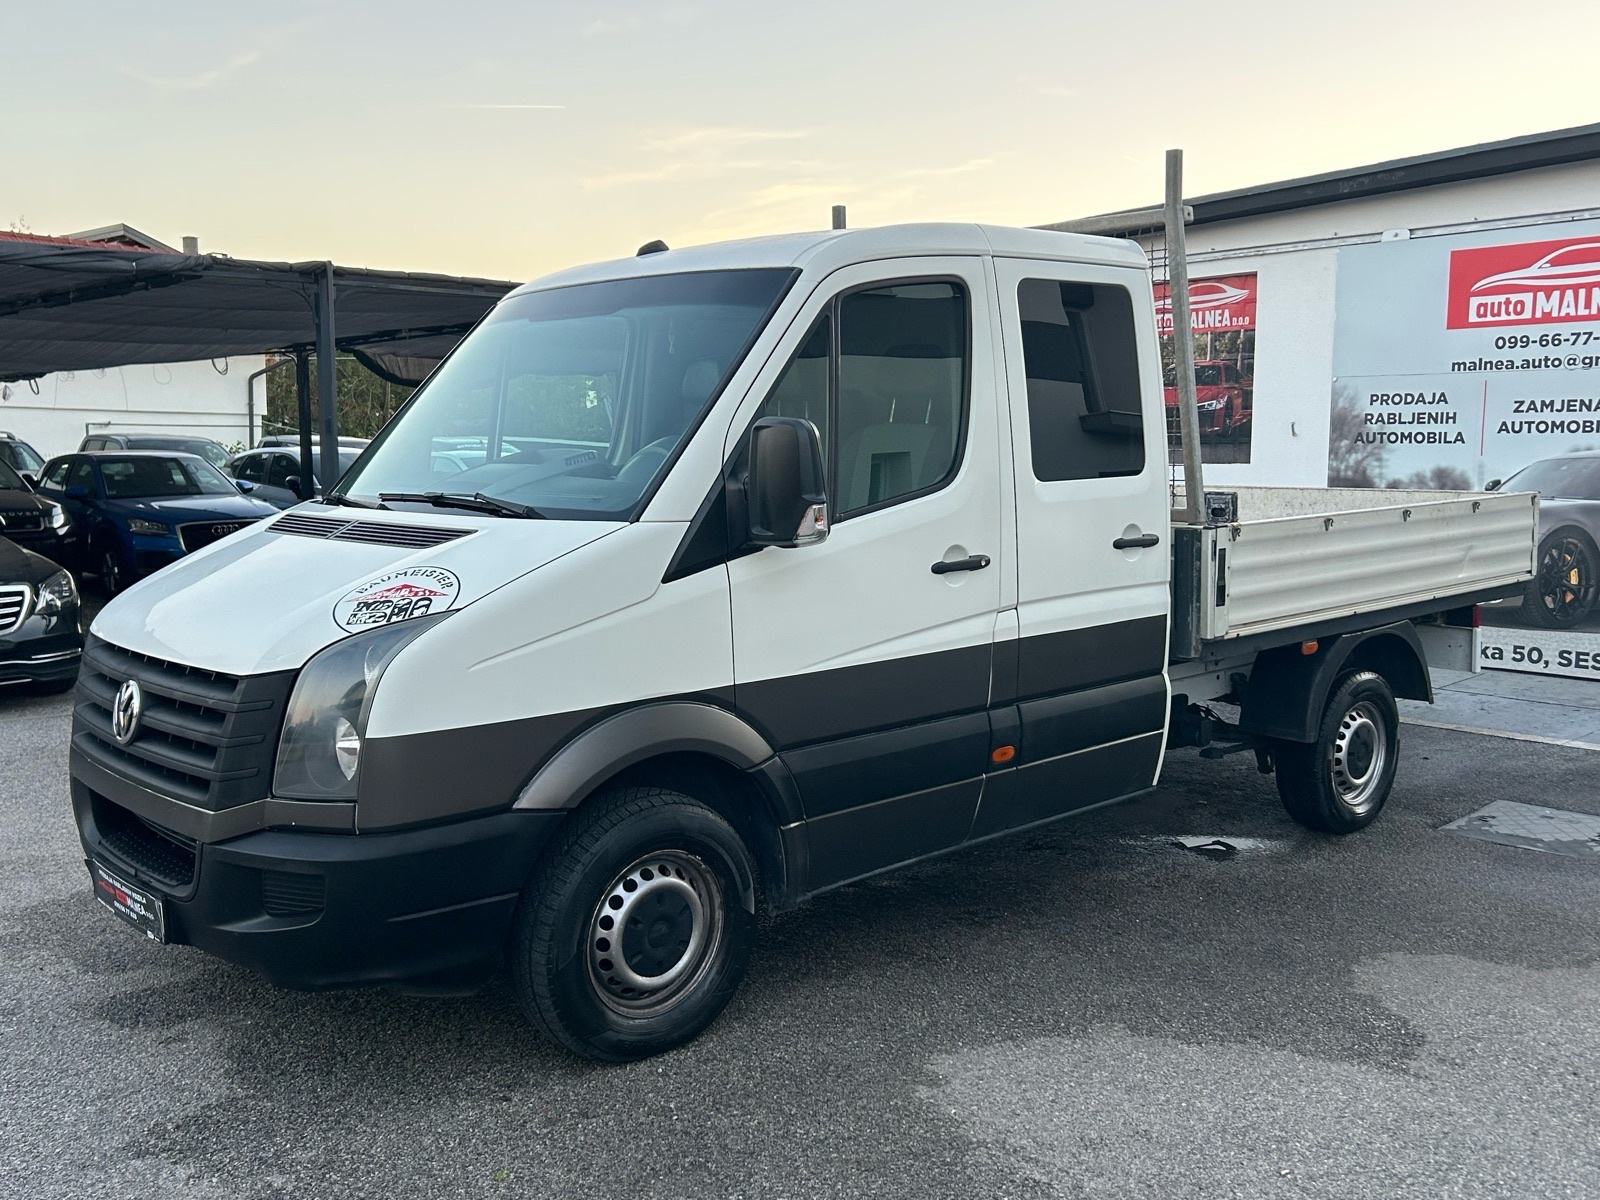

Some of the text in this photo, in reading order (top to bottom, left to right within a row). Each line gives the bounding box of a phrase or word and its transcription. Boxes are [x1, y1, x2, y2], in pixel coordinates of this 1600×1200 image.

[1190, 308, 1231, 329] ALNEA
[1475, 297, 1526, 319] auto
[1369, 391, 1449, 406] PRODAJA
[1363, 411, 1457, 425] RABLJENIH
[1353, 431, 1466, 445] AUTOMOBILA
[355, 569, 454, 594] BAUMEISTER
[1511, 644, 1550, 669] 50,
[1556, 649, 1600, 671] SES
